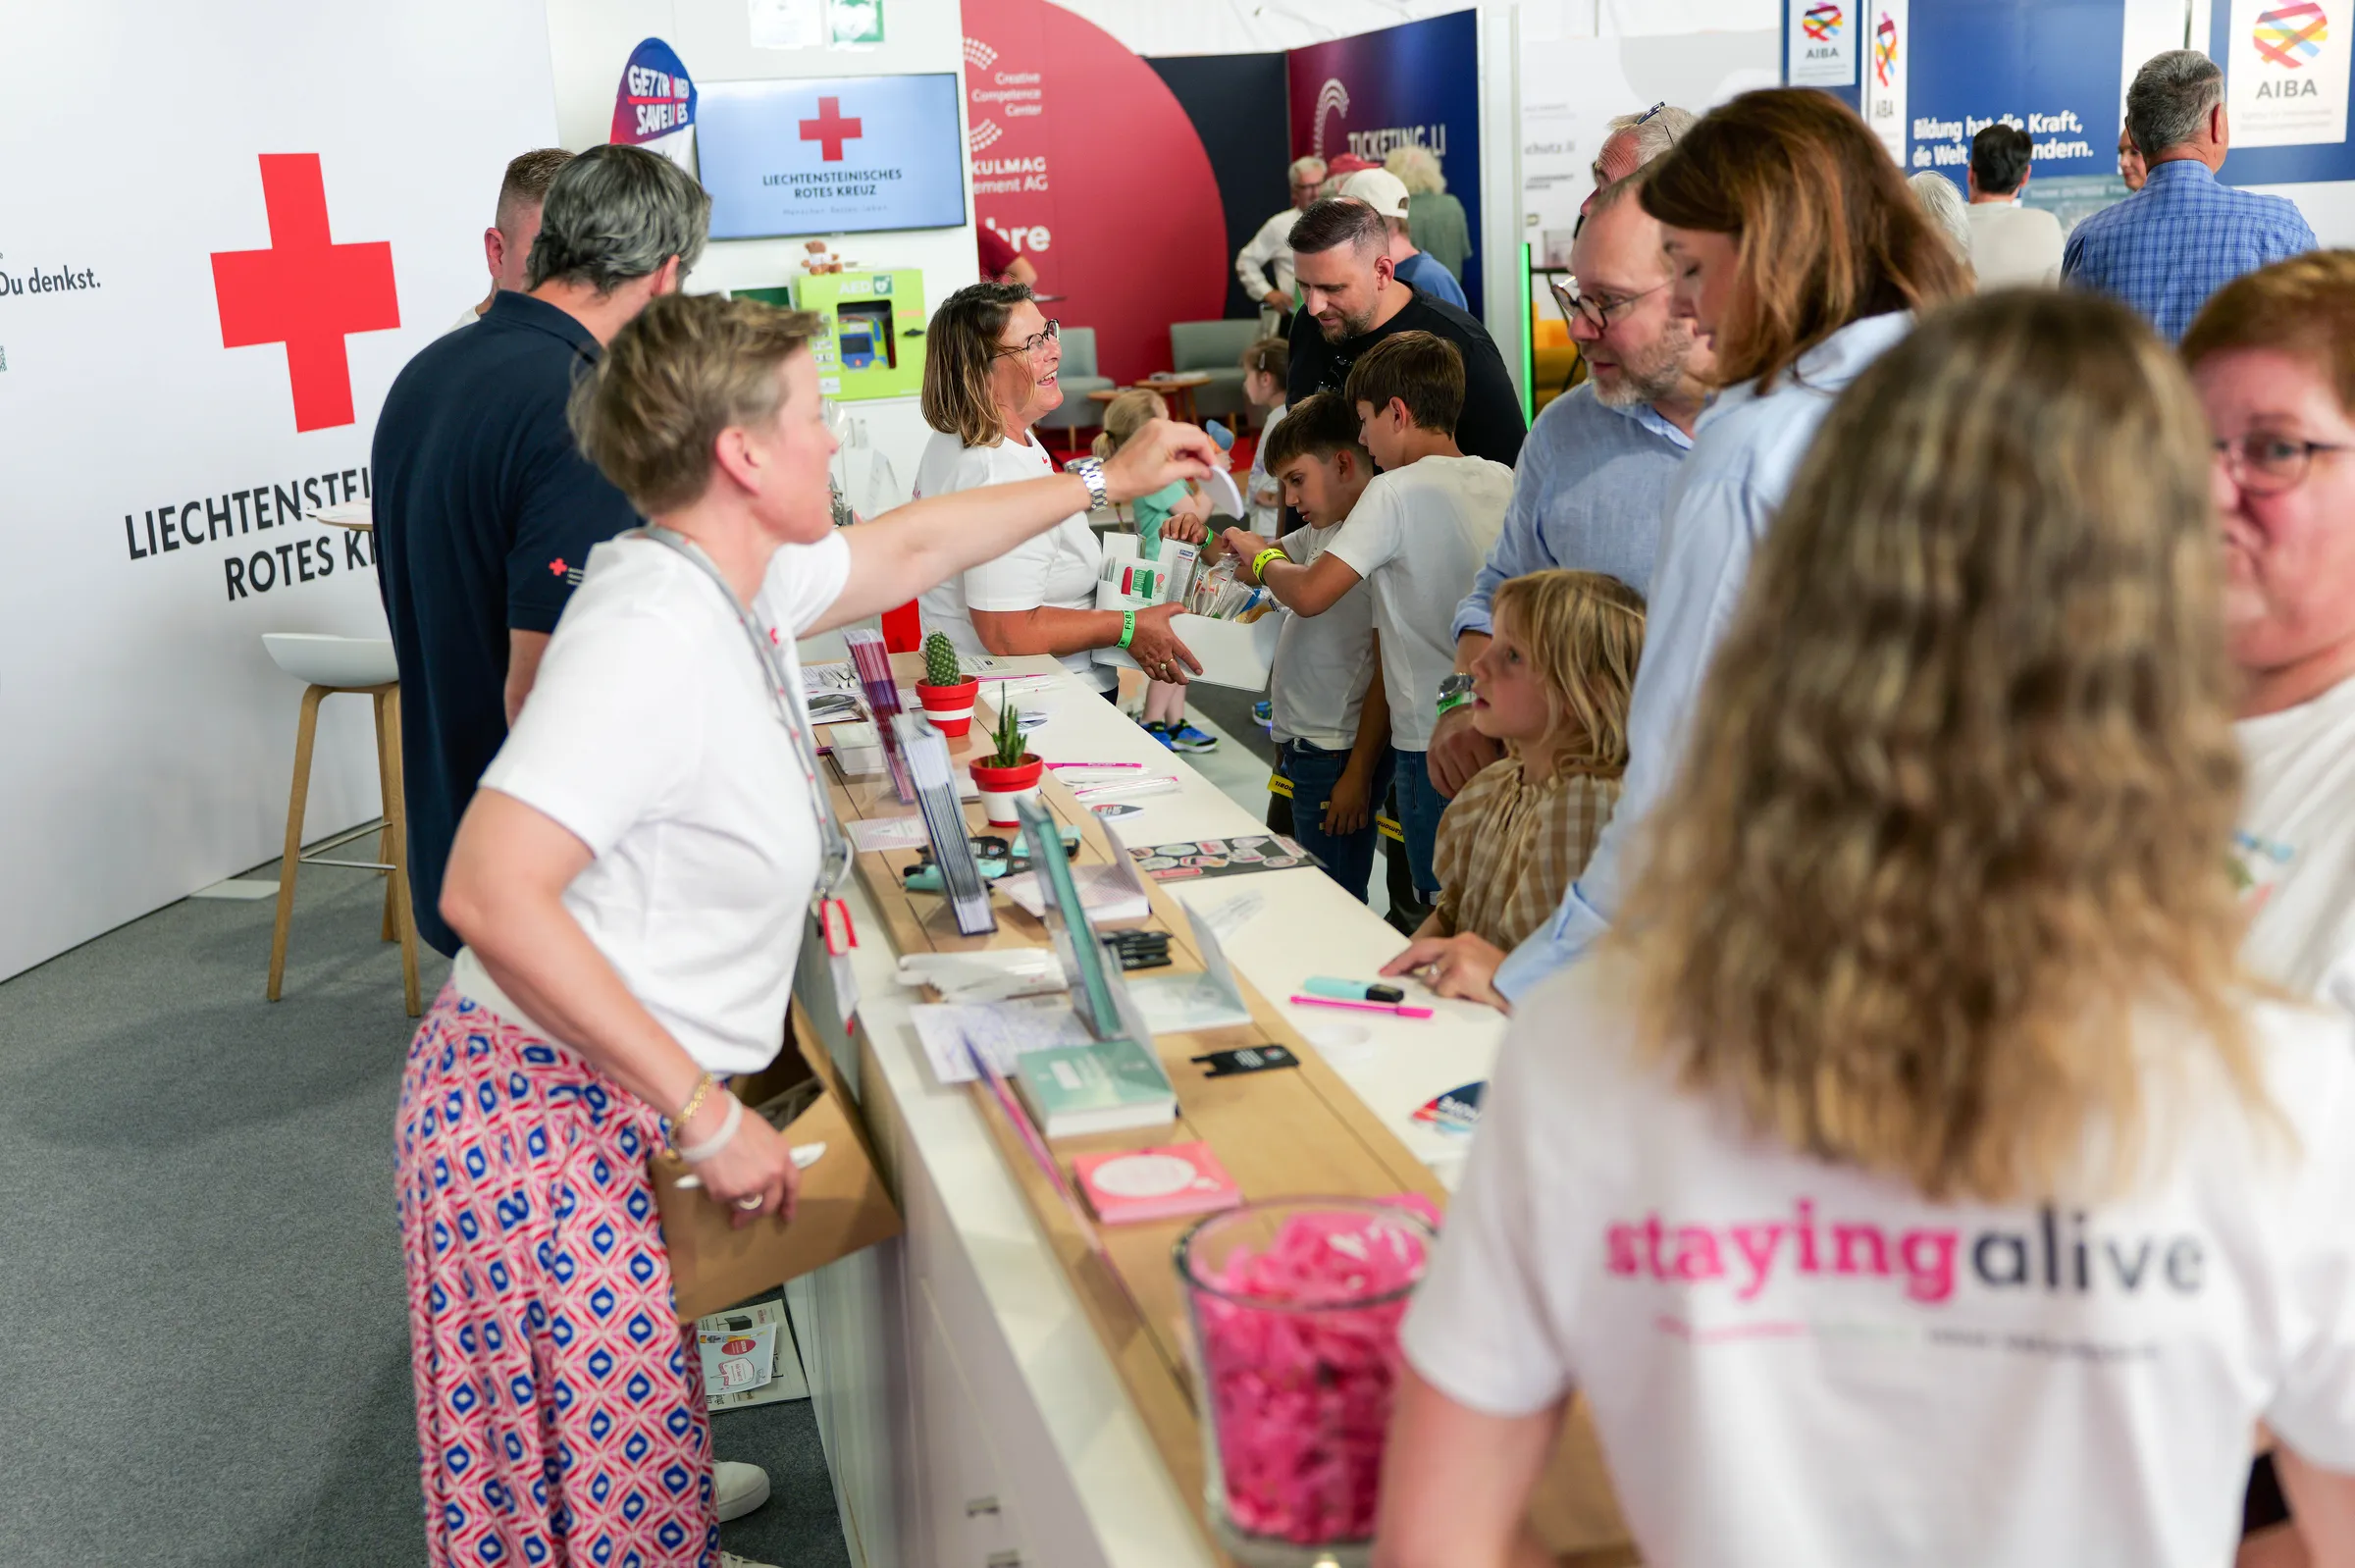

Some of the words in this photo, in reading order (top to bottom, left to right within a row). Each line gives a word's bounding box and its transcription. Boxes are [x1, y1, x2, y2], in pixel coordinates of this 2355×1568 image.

[1806, 47, 1840, 60] AIBA
[994, 72, 1041, 85] Creative
[970, 88, 1042, 104] Competence
[2255, 78, 2318, 100] AIBA
[1005, 103, 1042, 117] Center
[1913, 117, 1963, 143] Bildung
[2028, 109, 2083, 134] Kraft,
[762, 169, 903, 186] LIECHTENSTEINISCHES
[1023, 174, 1049, 191] AG
[794, 186, 833, 199] ROTES
[837, 183, 877, 197] KREUZ
[0, 270, 24, 296] Du
[28, 264, 101, 294] denkst.
[839, 281, 871, 295] AED
[225, 535, 335, 601] ROTES
